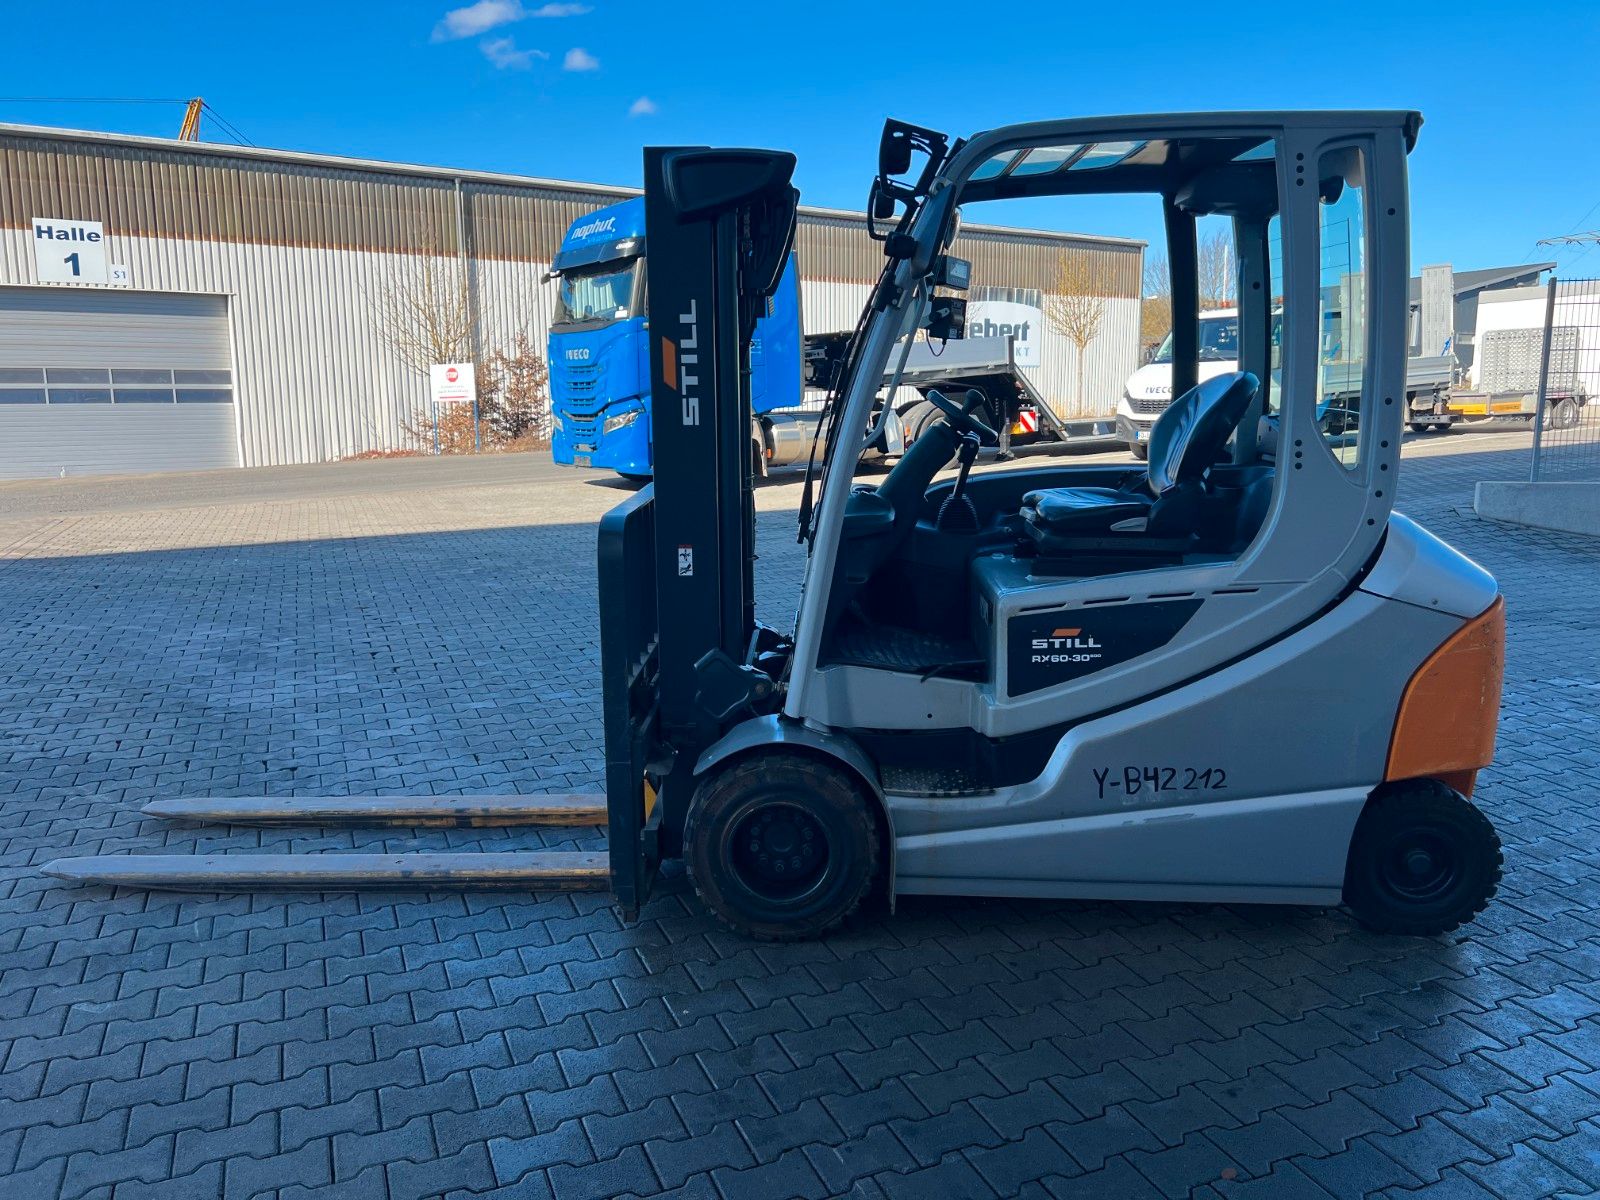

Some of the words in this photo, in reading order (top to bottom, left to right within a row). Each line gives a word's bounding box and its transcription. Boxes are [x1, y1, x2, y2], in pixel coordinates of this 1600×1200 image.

[36, 225, 101, 242] Halle
[64, 252, 80, 277] 1
[565, 348, 590, 360] IVECO
[679, 299, 699, 426] STILL
[1032, 638, 1101, 649] STILL
